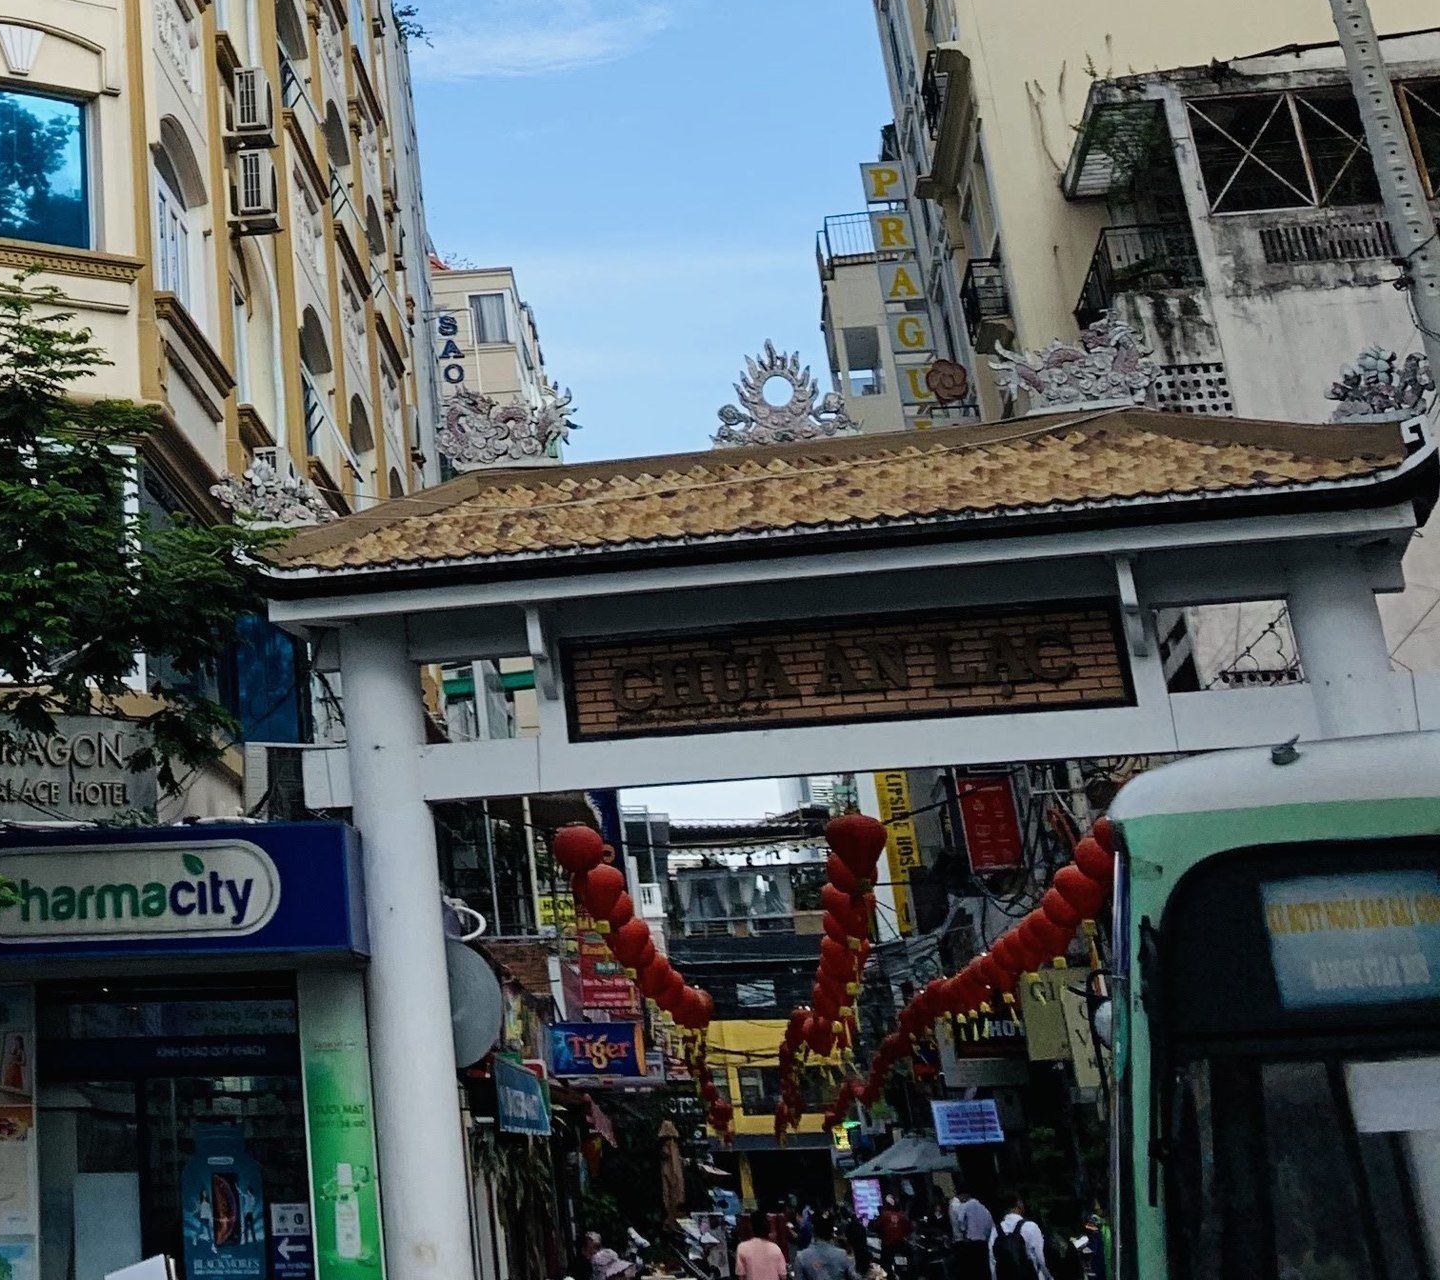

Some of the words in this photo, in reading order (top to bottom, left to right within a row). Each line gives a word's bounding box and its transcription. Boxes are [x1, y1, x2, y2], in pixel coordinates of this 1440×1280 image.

[815, 639, 911, 697] AN
[69, 781, 130, 806] HOTEL
[571, 1033, 631, 1071] Tiger
